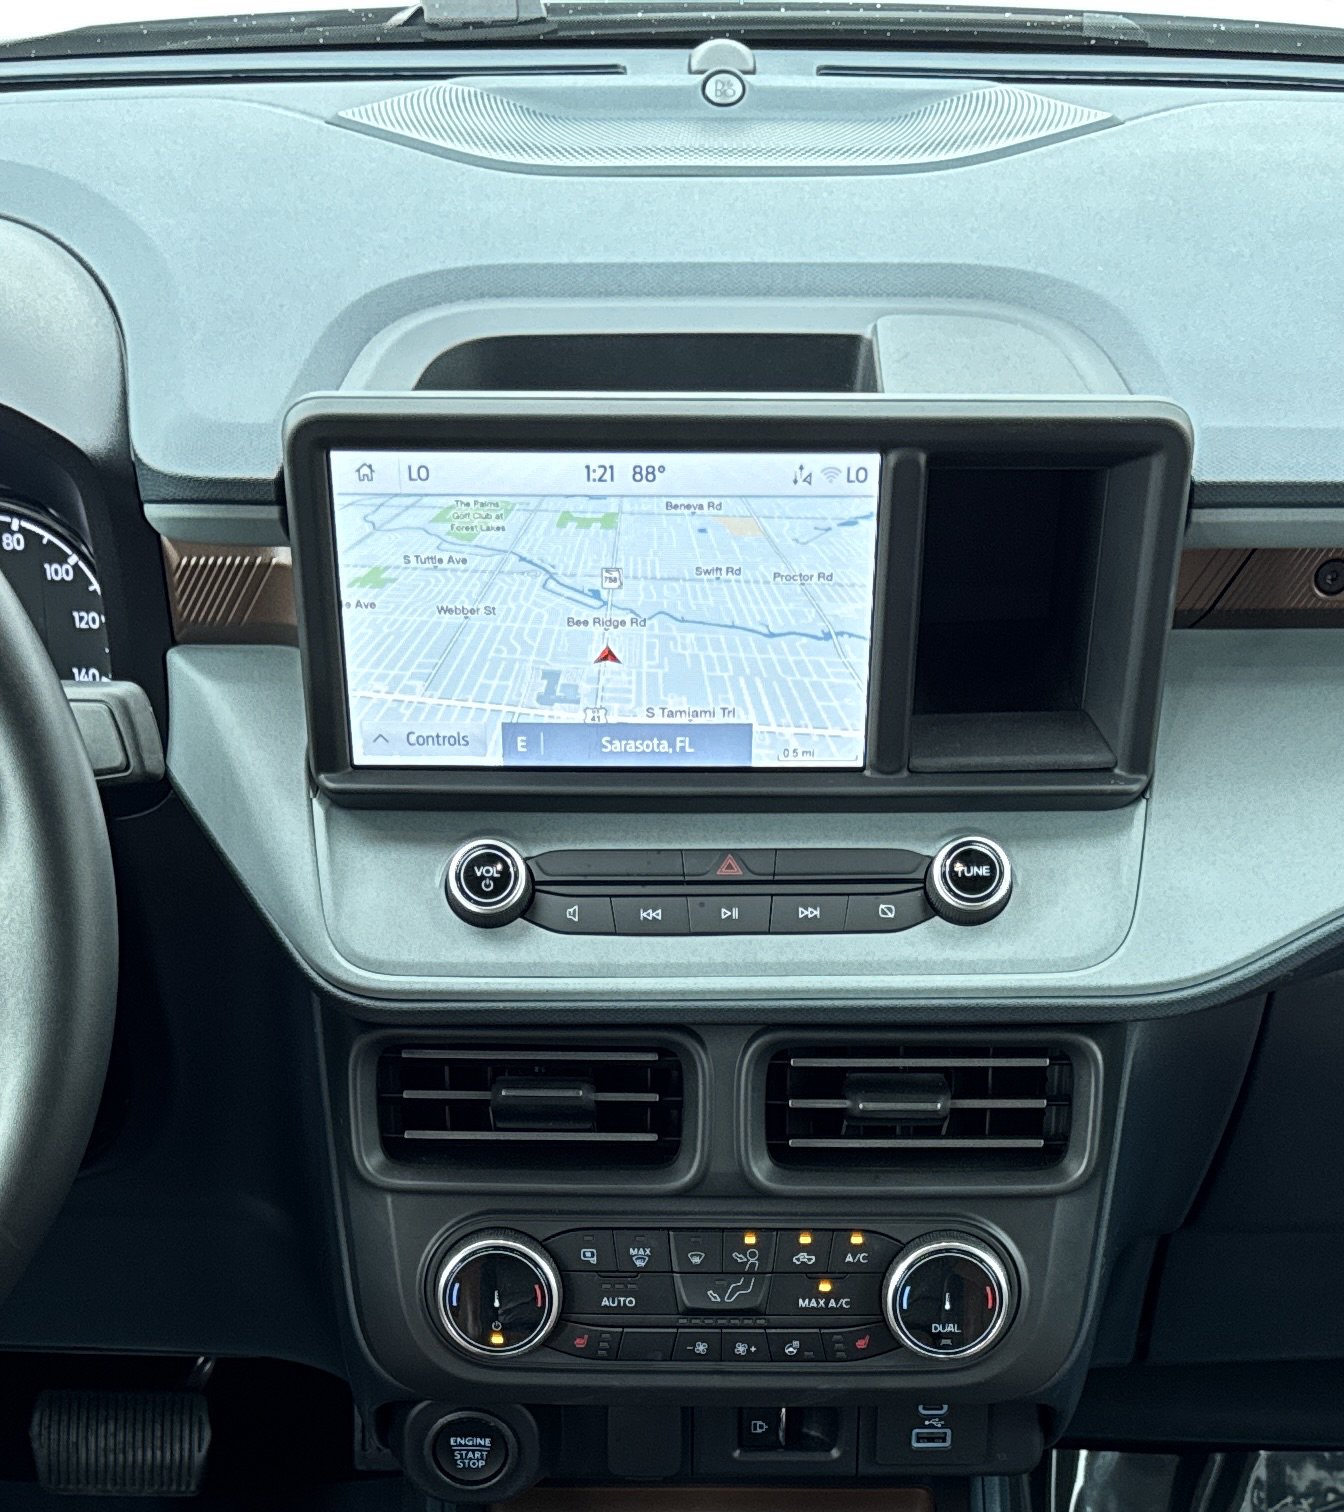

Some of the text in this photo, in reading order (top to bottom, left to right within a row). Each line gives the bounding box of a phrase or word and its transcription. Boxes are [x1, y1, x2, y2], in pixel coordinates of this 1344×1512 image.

[407, 465, 430, 482] LO
[584, 465, 615, 483] 1:21
[846, 466, 868, 484] LO
[455, 500, 500, 509] The Palms
[665, 501, 722, 511] Beneva Rd
[453, 511, 504, 521] Golf Club at
[450, 524, 506, 533] Forest Lakes
[2, 533, 25, 551] 80
[403, 555, 468, 566] S Tuttle Ave
[44, 563, 74, 581] 100
[695, 567, 742, 577] Swift Rd
[773, 572, 834, 583] Proctor Rd
[355, 600, 377, 610] Ave
[436, 605, 496, 616] Webber St
[72, 611, 100, 629] 120
[567, 616, 647, 630] Bee Ridge Rd
[646, 707, 736, 719] S Tamiami Trl
[590, 715, 601, 723] 41
[406, 731, 470, 747] Controls
[517, 736, 527, 752] E
[601, 736, 695, 754] Sarasota, FL
[801, 748, 815, 758] mi
[474, 866, 501, 877] VOL
[955, 865, 990, 877] TUNE
[629, 1248, 651, 1256] MAX
[845, 1253, 869, 1263] A/C
[601, 1297, 636, 1307] AUTO
[799, 1298, 851, 1309] MAX A/C
[931, 1323, 962, 1333] DUAL
[450, 1436, 492, 1446] ENGINE
[454, 1450, 488, 1460] START
[456, 1460, 486, 1469] STOP
